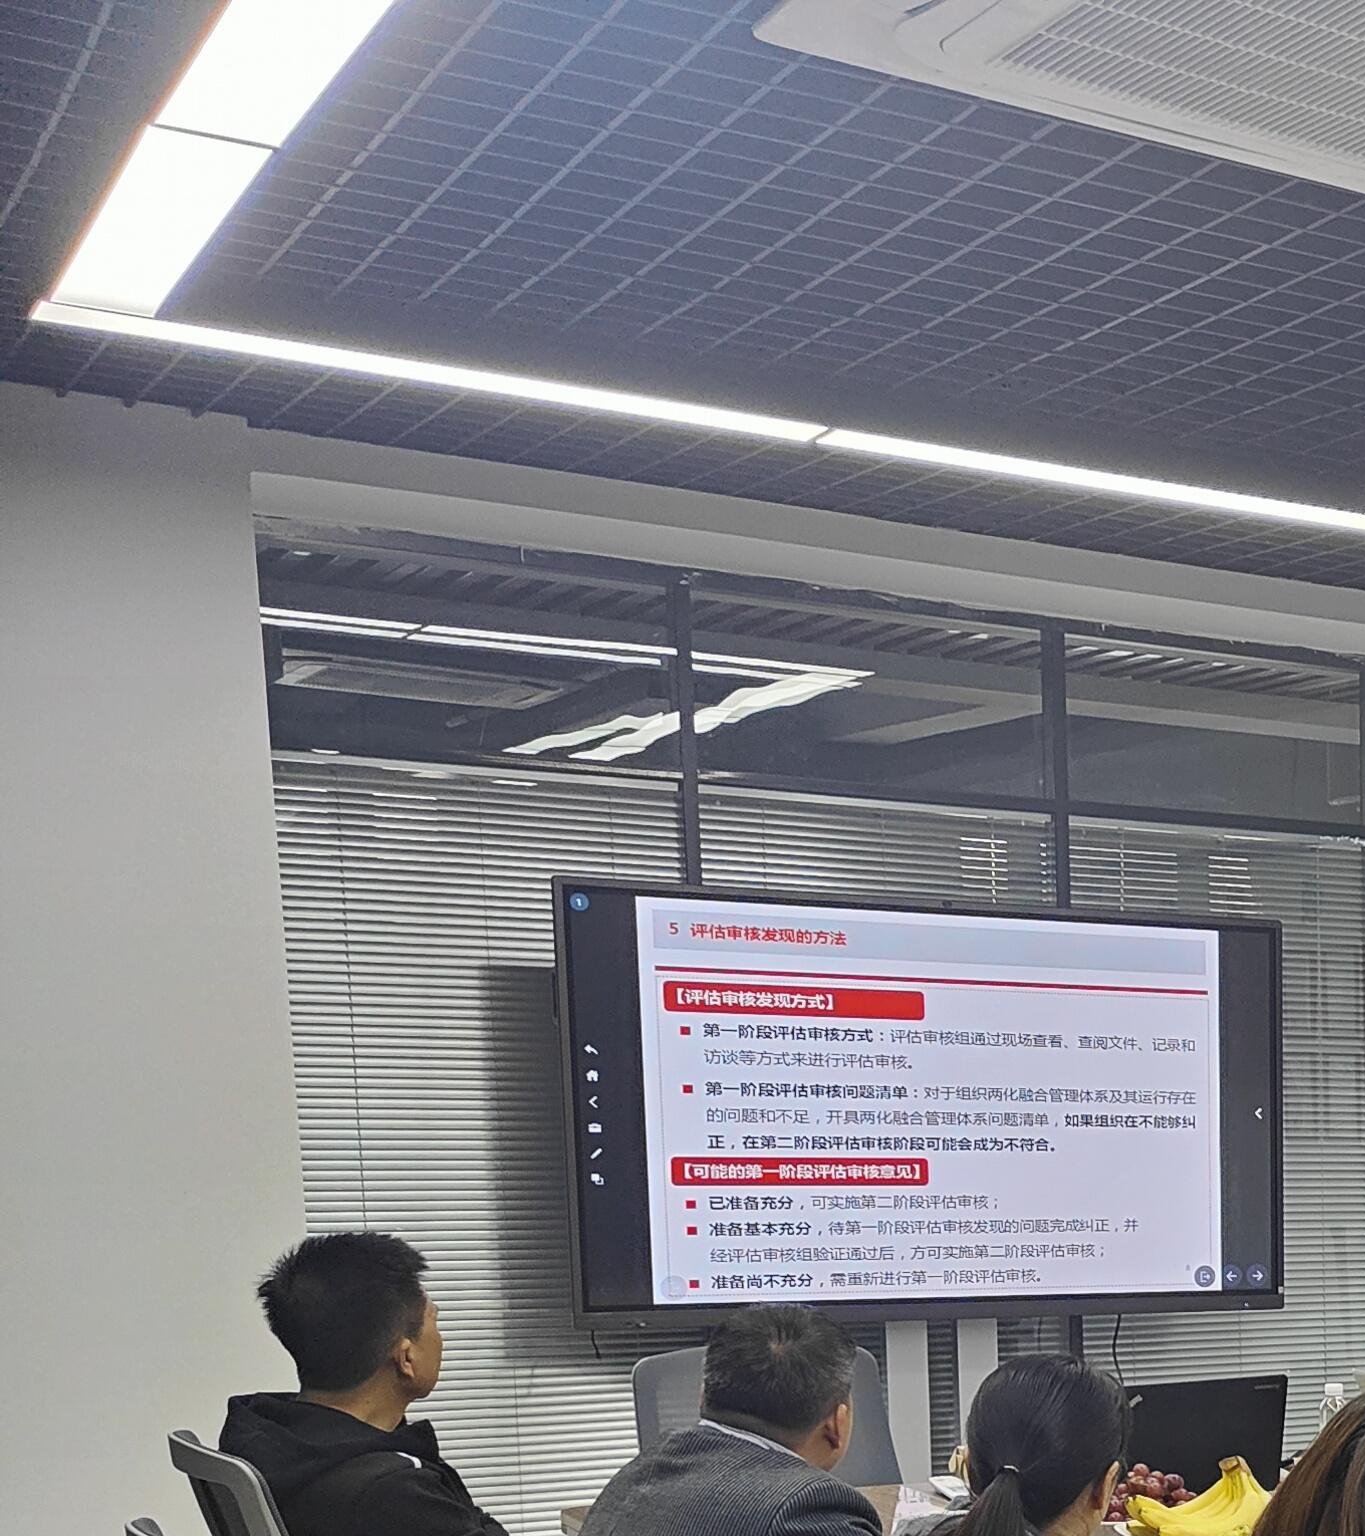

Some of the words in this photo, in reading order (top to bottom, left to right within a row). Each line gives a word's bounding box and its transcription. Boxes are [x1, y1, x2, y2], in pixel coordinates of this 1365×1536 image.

[668, 922, 679, 935] 5
[690, 923, 848, 946] 评估审核发现的方法
[675, 988, 835, 1010] 【评估审核发现方式】
[703, 1049, 913, 1070] 访谈等方式来进行评估审核。
[706, 1134, 1056, 1153] 正，在第二阶段评估审核阶段可能会成为不符合。
[682, 1162, 922, 1181] 【可能的第一阶段评估审核意见】
[708, 1195, 1000, 1212] 已准备充分，可实施第二阶段评估审核；
[708, 1218, 1140, 1237] 准备基本充分，待第一阶段评估审核发现的问题完成纠正，并
[710, 1243, 1105, 1265] 经评估审核组验证通过后，方可实施第二阶段评估审核；
[711, 1267, 1042, 1290] 准备尚不充分，需重新进行第一阶段评估审核。
